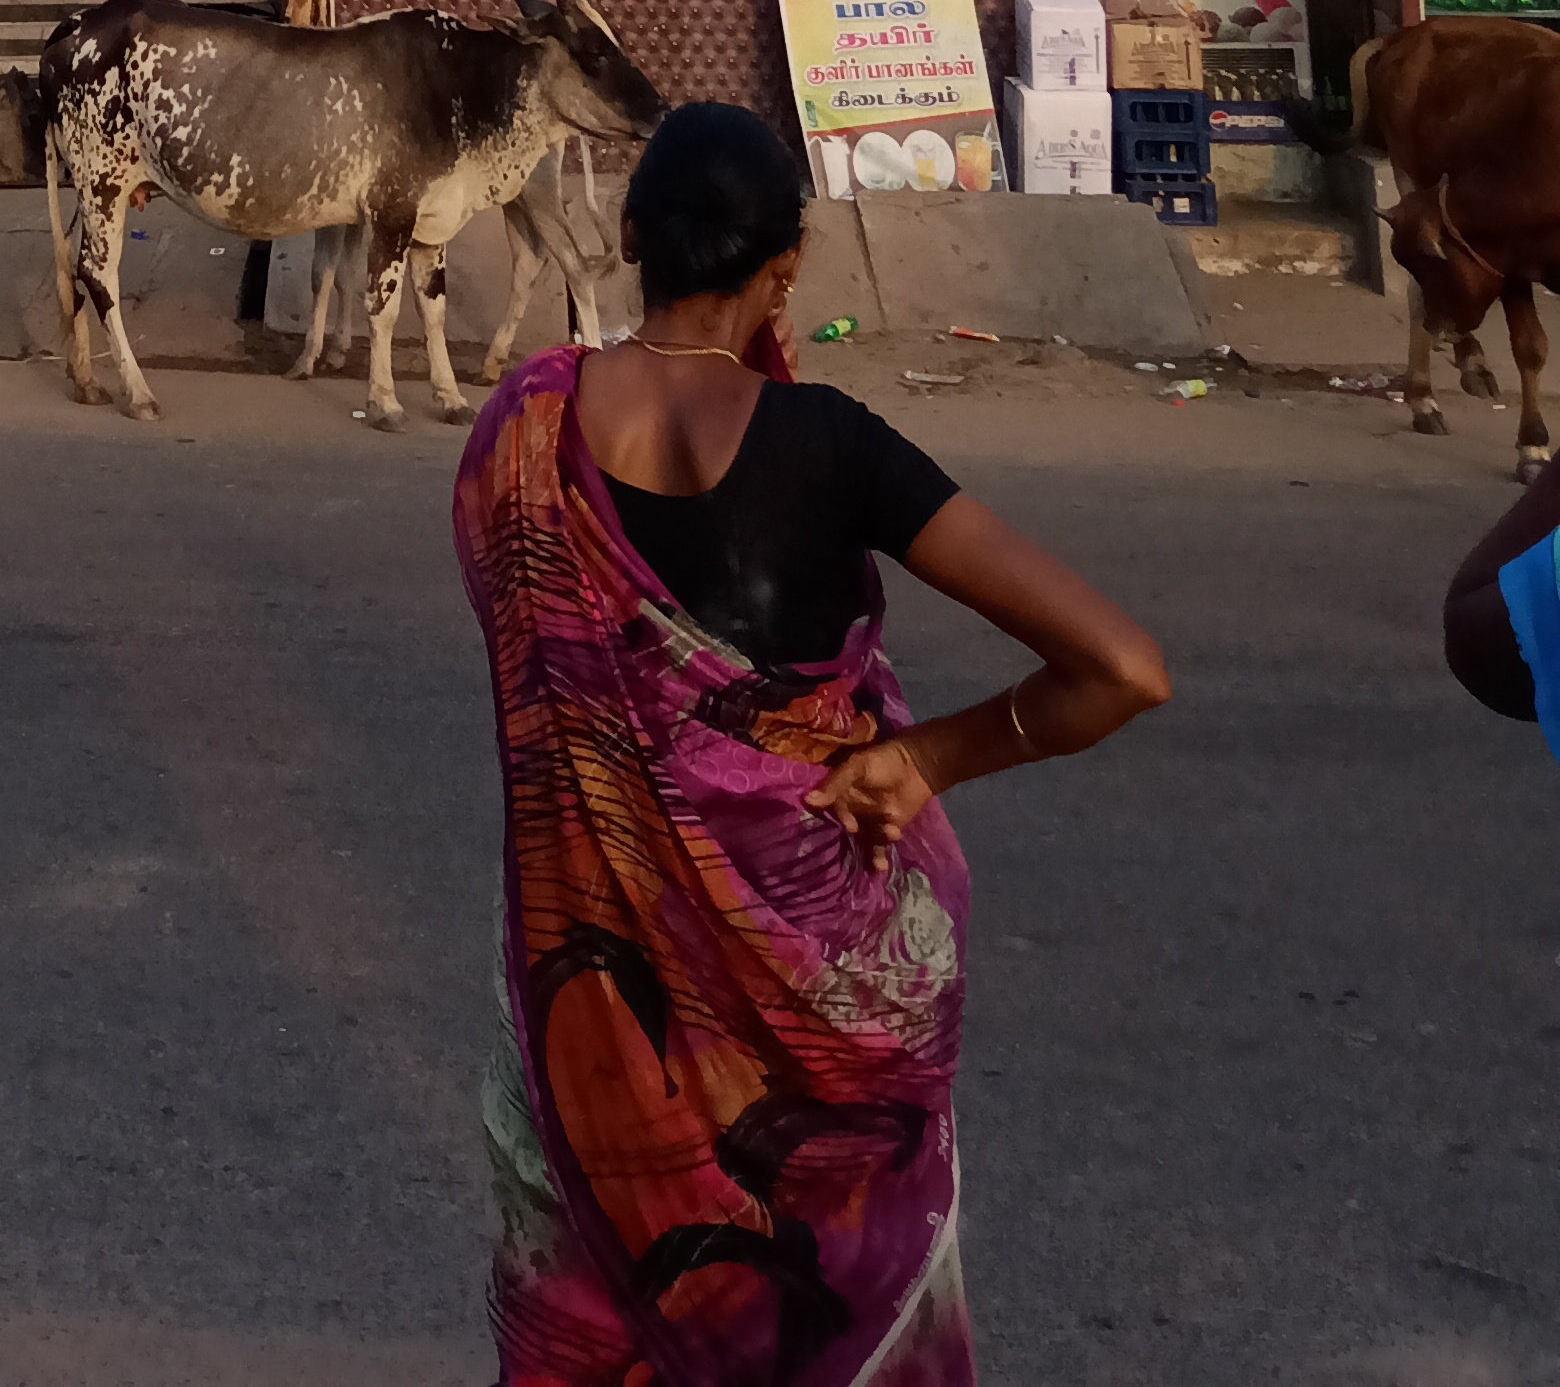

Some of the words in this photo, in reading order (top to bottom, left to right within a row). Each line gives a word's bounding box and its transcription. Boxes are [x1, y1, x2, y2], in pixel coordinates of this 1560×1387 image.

[834, 22, 935, 52] தயிர்
[806, 58, 861, 85] குளிர்
[866, 53, 975, 79] பானங்கள்
[831, 85, 961, 108] கிடைக்கும்
